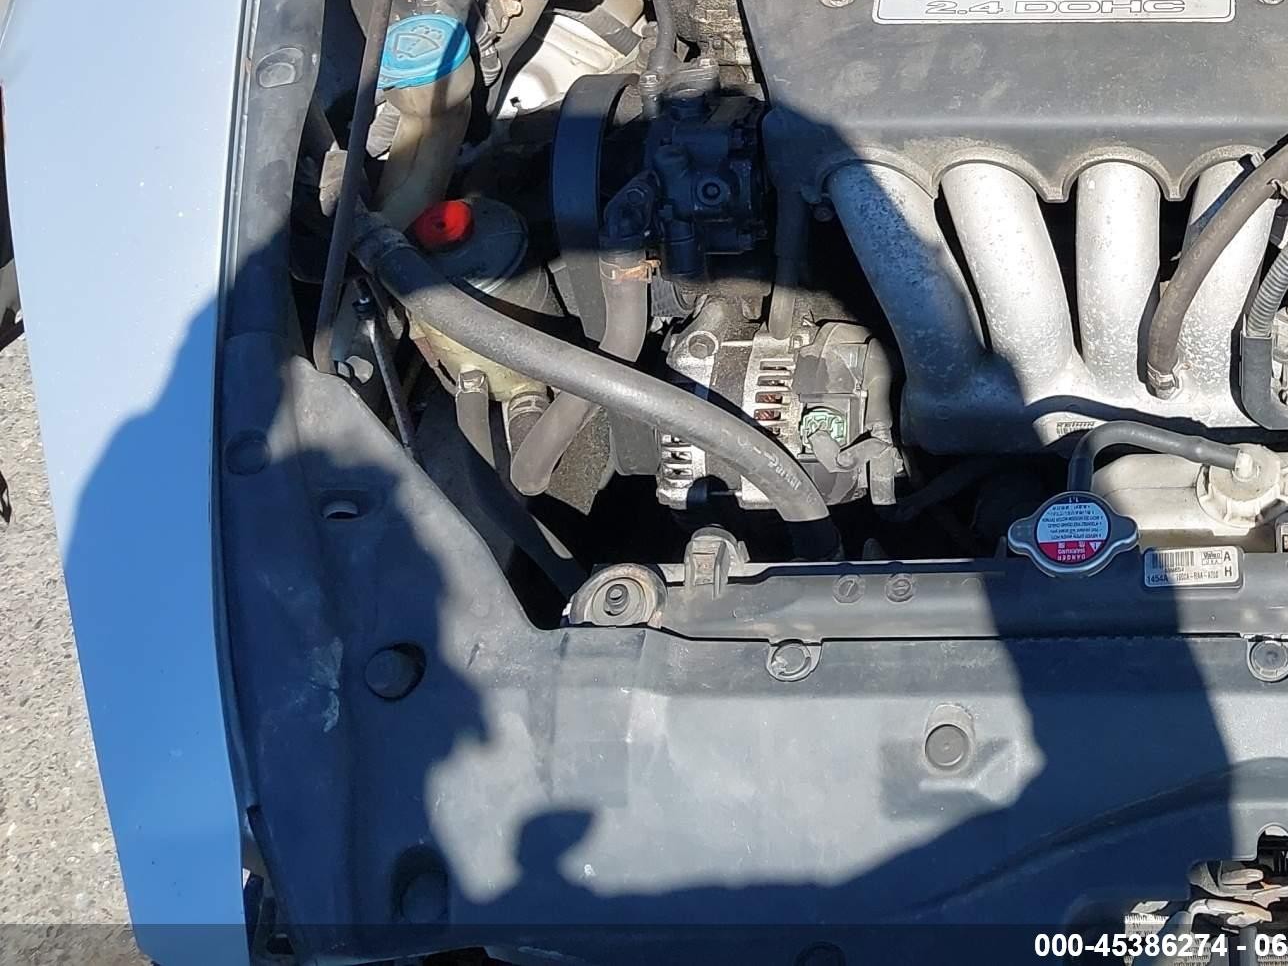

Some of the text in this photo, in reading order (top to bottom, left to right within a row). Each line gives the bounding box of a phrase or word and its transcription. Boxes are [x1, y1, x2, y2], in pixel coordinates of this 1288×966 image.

[925, 0, 1003, 15] 2.4
[1223, 551, 1231, 562] A
[1224, 566, 1232, 577] H
